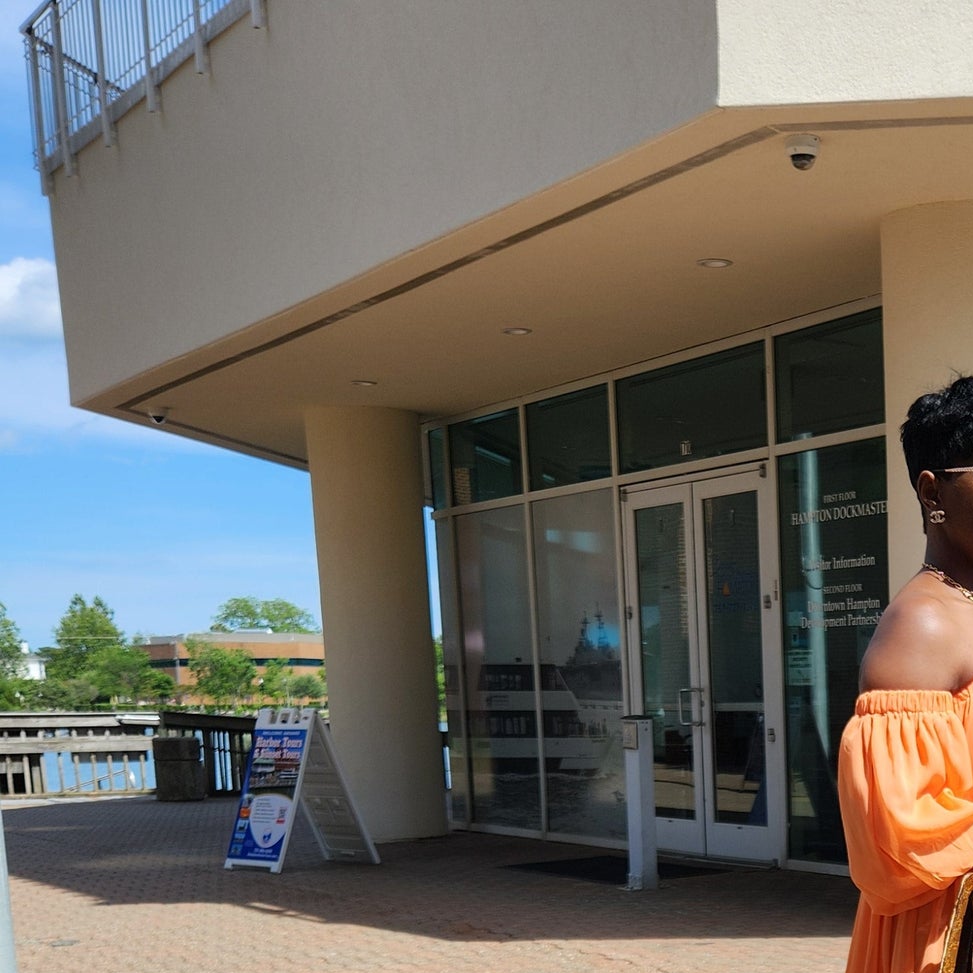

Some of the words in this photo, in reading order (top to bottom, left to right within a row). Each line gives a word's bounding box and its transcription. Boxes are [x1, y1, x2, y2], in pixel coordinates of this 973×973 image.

[791, 508, 832, 526] HAMPTON
[833, 500, 888, 520] DOCKMASTE
[832, 554, 876, 570] Information
[807, 600, 846, 613] Dntown
[846, 597, 881, 613] Hampton
